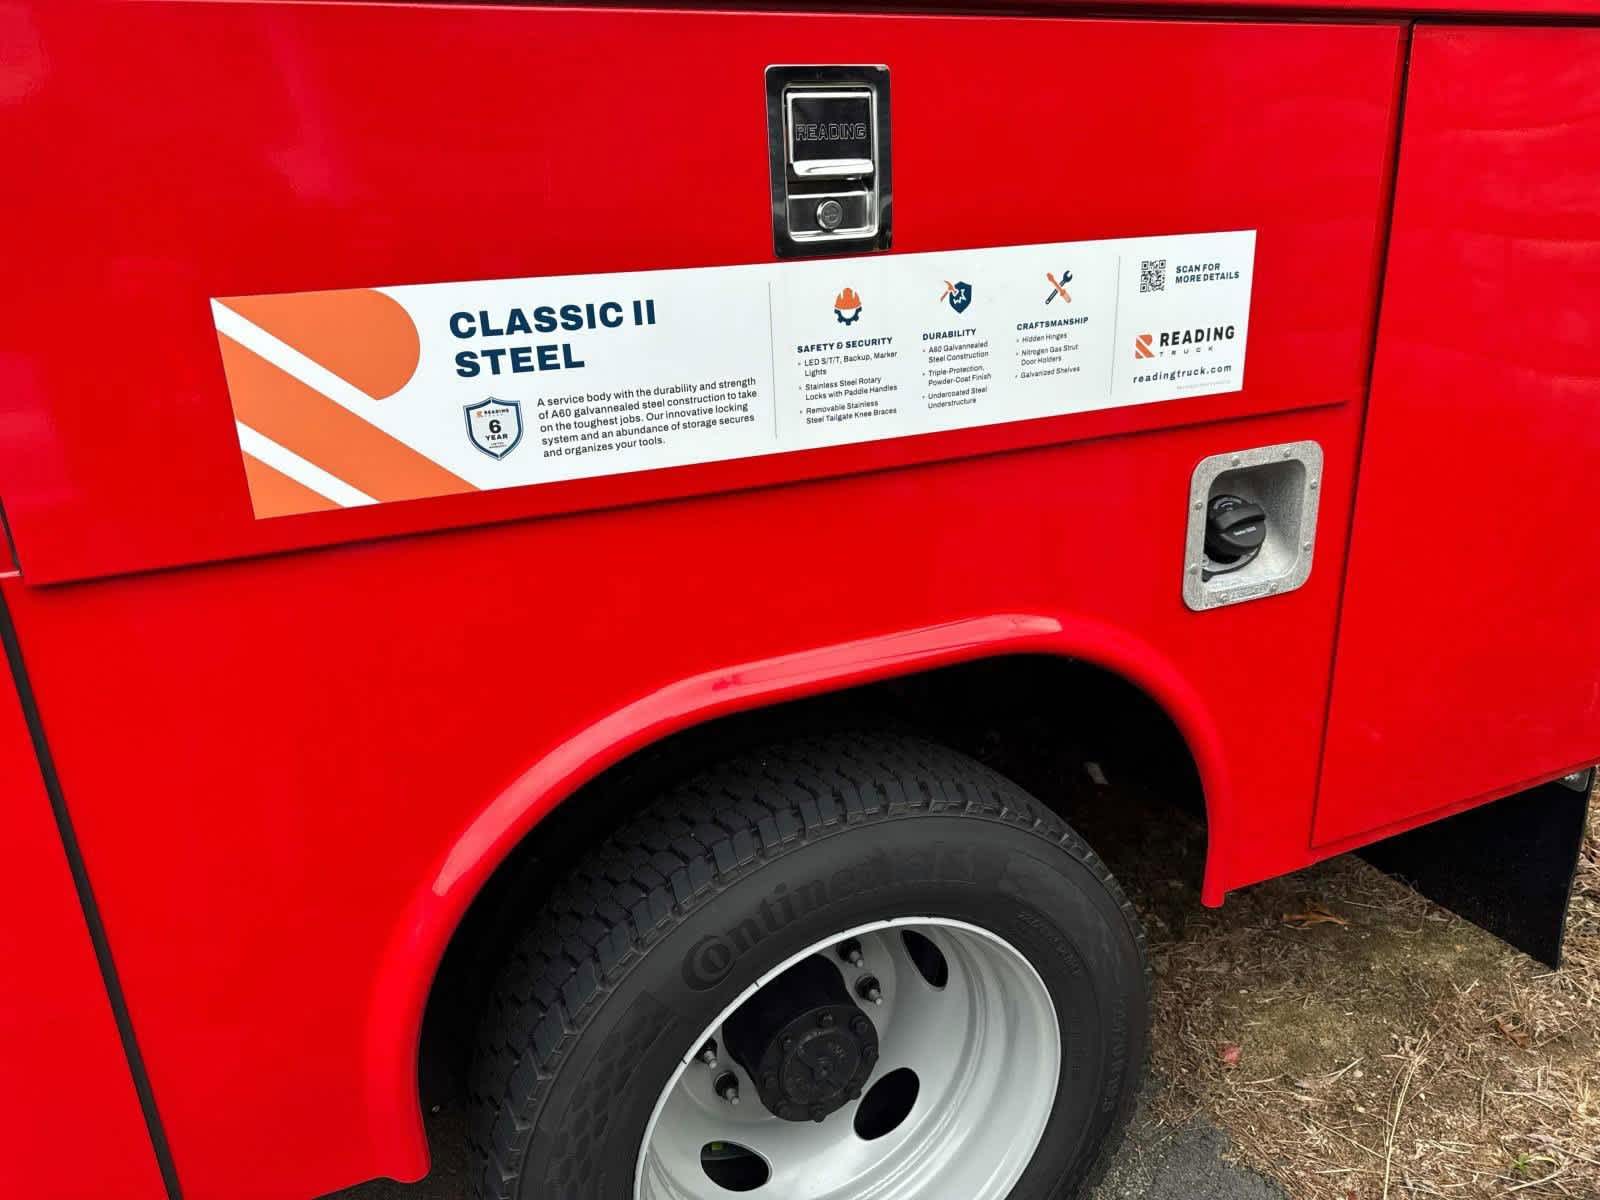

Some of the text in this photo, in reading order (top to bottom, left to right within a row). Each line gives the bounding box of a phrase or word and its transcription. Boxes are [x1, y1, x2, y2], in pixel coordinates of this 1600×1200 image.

[795, 123, 867, 141] READING
[1176, 263, 1220, 274] SCAN FOR
[1175, 271, 1239, 284] MORE DETAILS
[450, 299, 656, 339] CLASSIC II
[1017, 317, 1088, 331] CRAFTSMANSHIP
[923, 328, 976, 341] DURABILITY
[1046, 333, 1067, 341] Hinges
[1160, 325, 1234, 347] READING
[797, 343, 835, 353] SAFETY
[845, 337, 892, 348] SECURITY
[943, 341, 988, 352] Galvannealed
[1021, 348, 1048, 356] Nitrogen
[455, 343, 585, 378] STEEL
[804, 358, 820, 367] LED
[873, 351, 897, 359] Marker
[928, 351, 988, 363] Steel Construction
[805, 369, 827, 378] Lights
[1020, 366, 1080, 378] Galvanized Shelves
[1133, 365, 1231, 383] readingtruck.com
[805, 382, 838, 391] Stainless
[840, 378, 857, 387] Steel
[928, 375, 971, 386] Powder-Coat
[537, 377, 756, 407] A service body with the durability and strength
[805, 384, 897, 400] Locks with Paddle Handles
[928, 386, 987, 399] Undercoated Steel
[538, 389, 757, 420] of A60 galvannealed steel construction to take
[806, 401, 878, 414] Removable Stainless
[928, 398, 976, 409] Understructure
[555, 421, 572, 431] the
[573, 416, 618, 429] toughest
[620, 414, 643, 426] jobs.
[646, 412, 664, 421] Our
[666, 407, 713, 419] innovative
[715, 403, 748, 413] locking
[806, 416, 824, 424] Steel
[826, 413, 853, 422] Tailgate
[873, 408, 897, 416] Braces
[489, 419, 502, 434] 6
[542, 435, 579, 446] system
[580, 430, 599, 441] and
[616, 425, 669, 437] abundance
[671, 421, 680, 430] of
[682, 419, 717, 429] storage
[719, 415, 755, 425] secures
[485, 433, 509, 441] YEAR
[544, 436, 665, 458] and organizes your tools.
